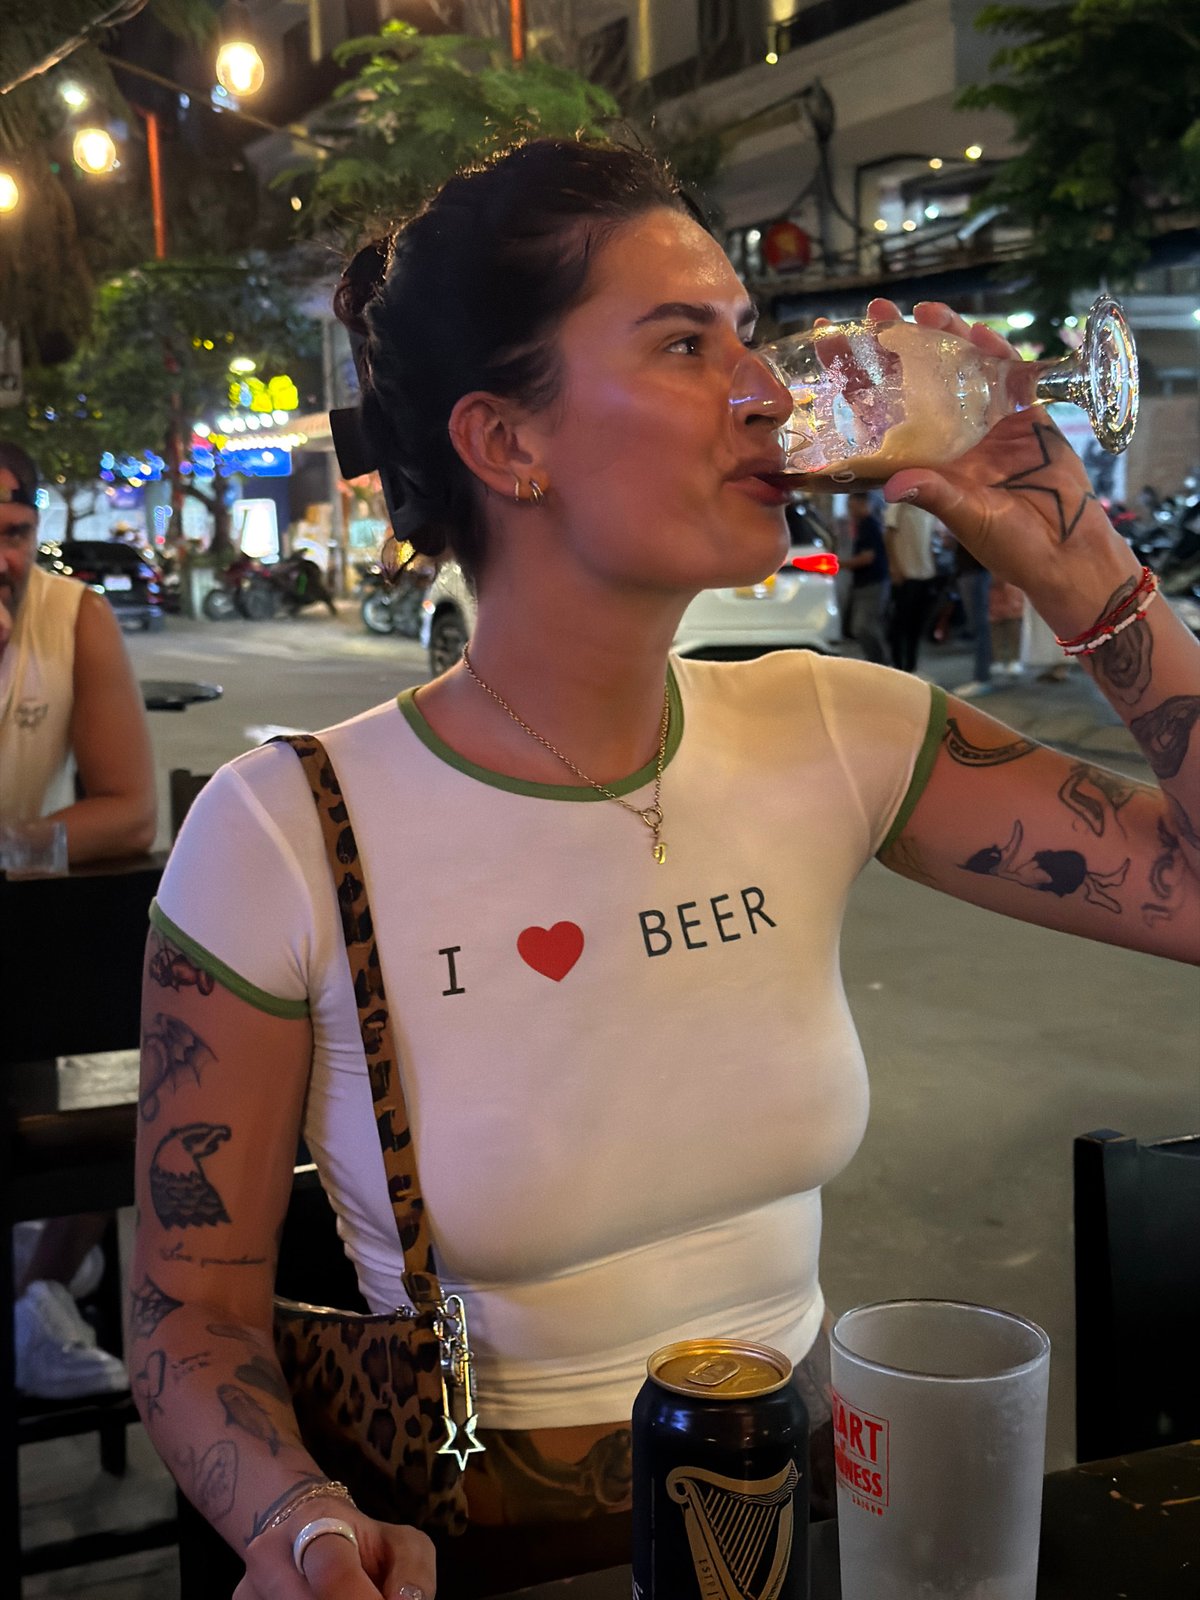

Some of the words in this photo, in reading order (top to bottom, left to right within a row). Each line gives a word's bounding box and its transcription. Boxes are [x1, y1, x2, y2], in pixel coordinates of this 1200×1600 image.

[438, 945, 466, 997] I
[637, 885, 778, 958] BEER
[833, 1396, 883, 1462] ART
